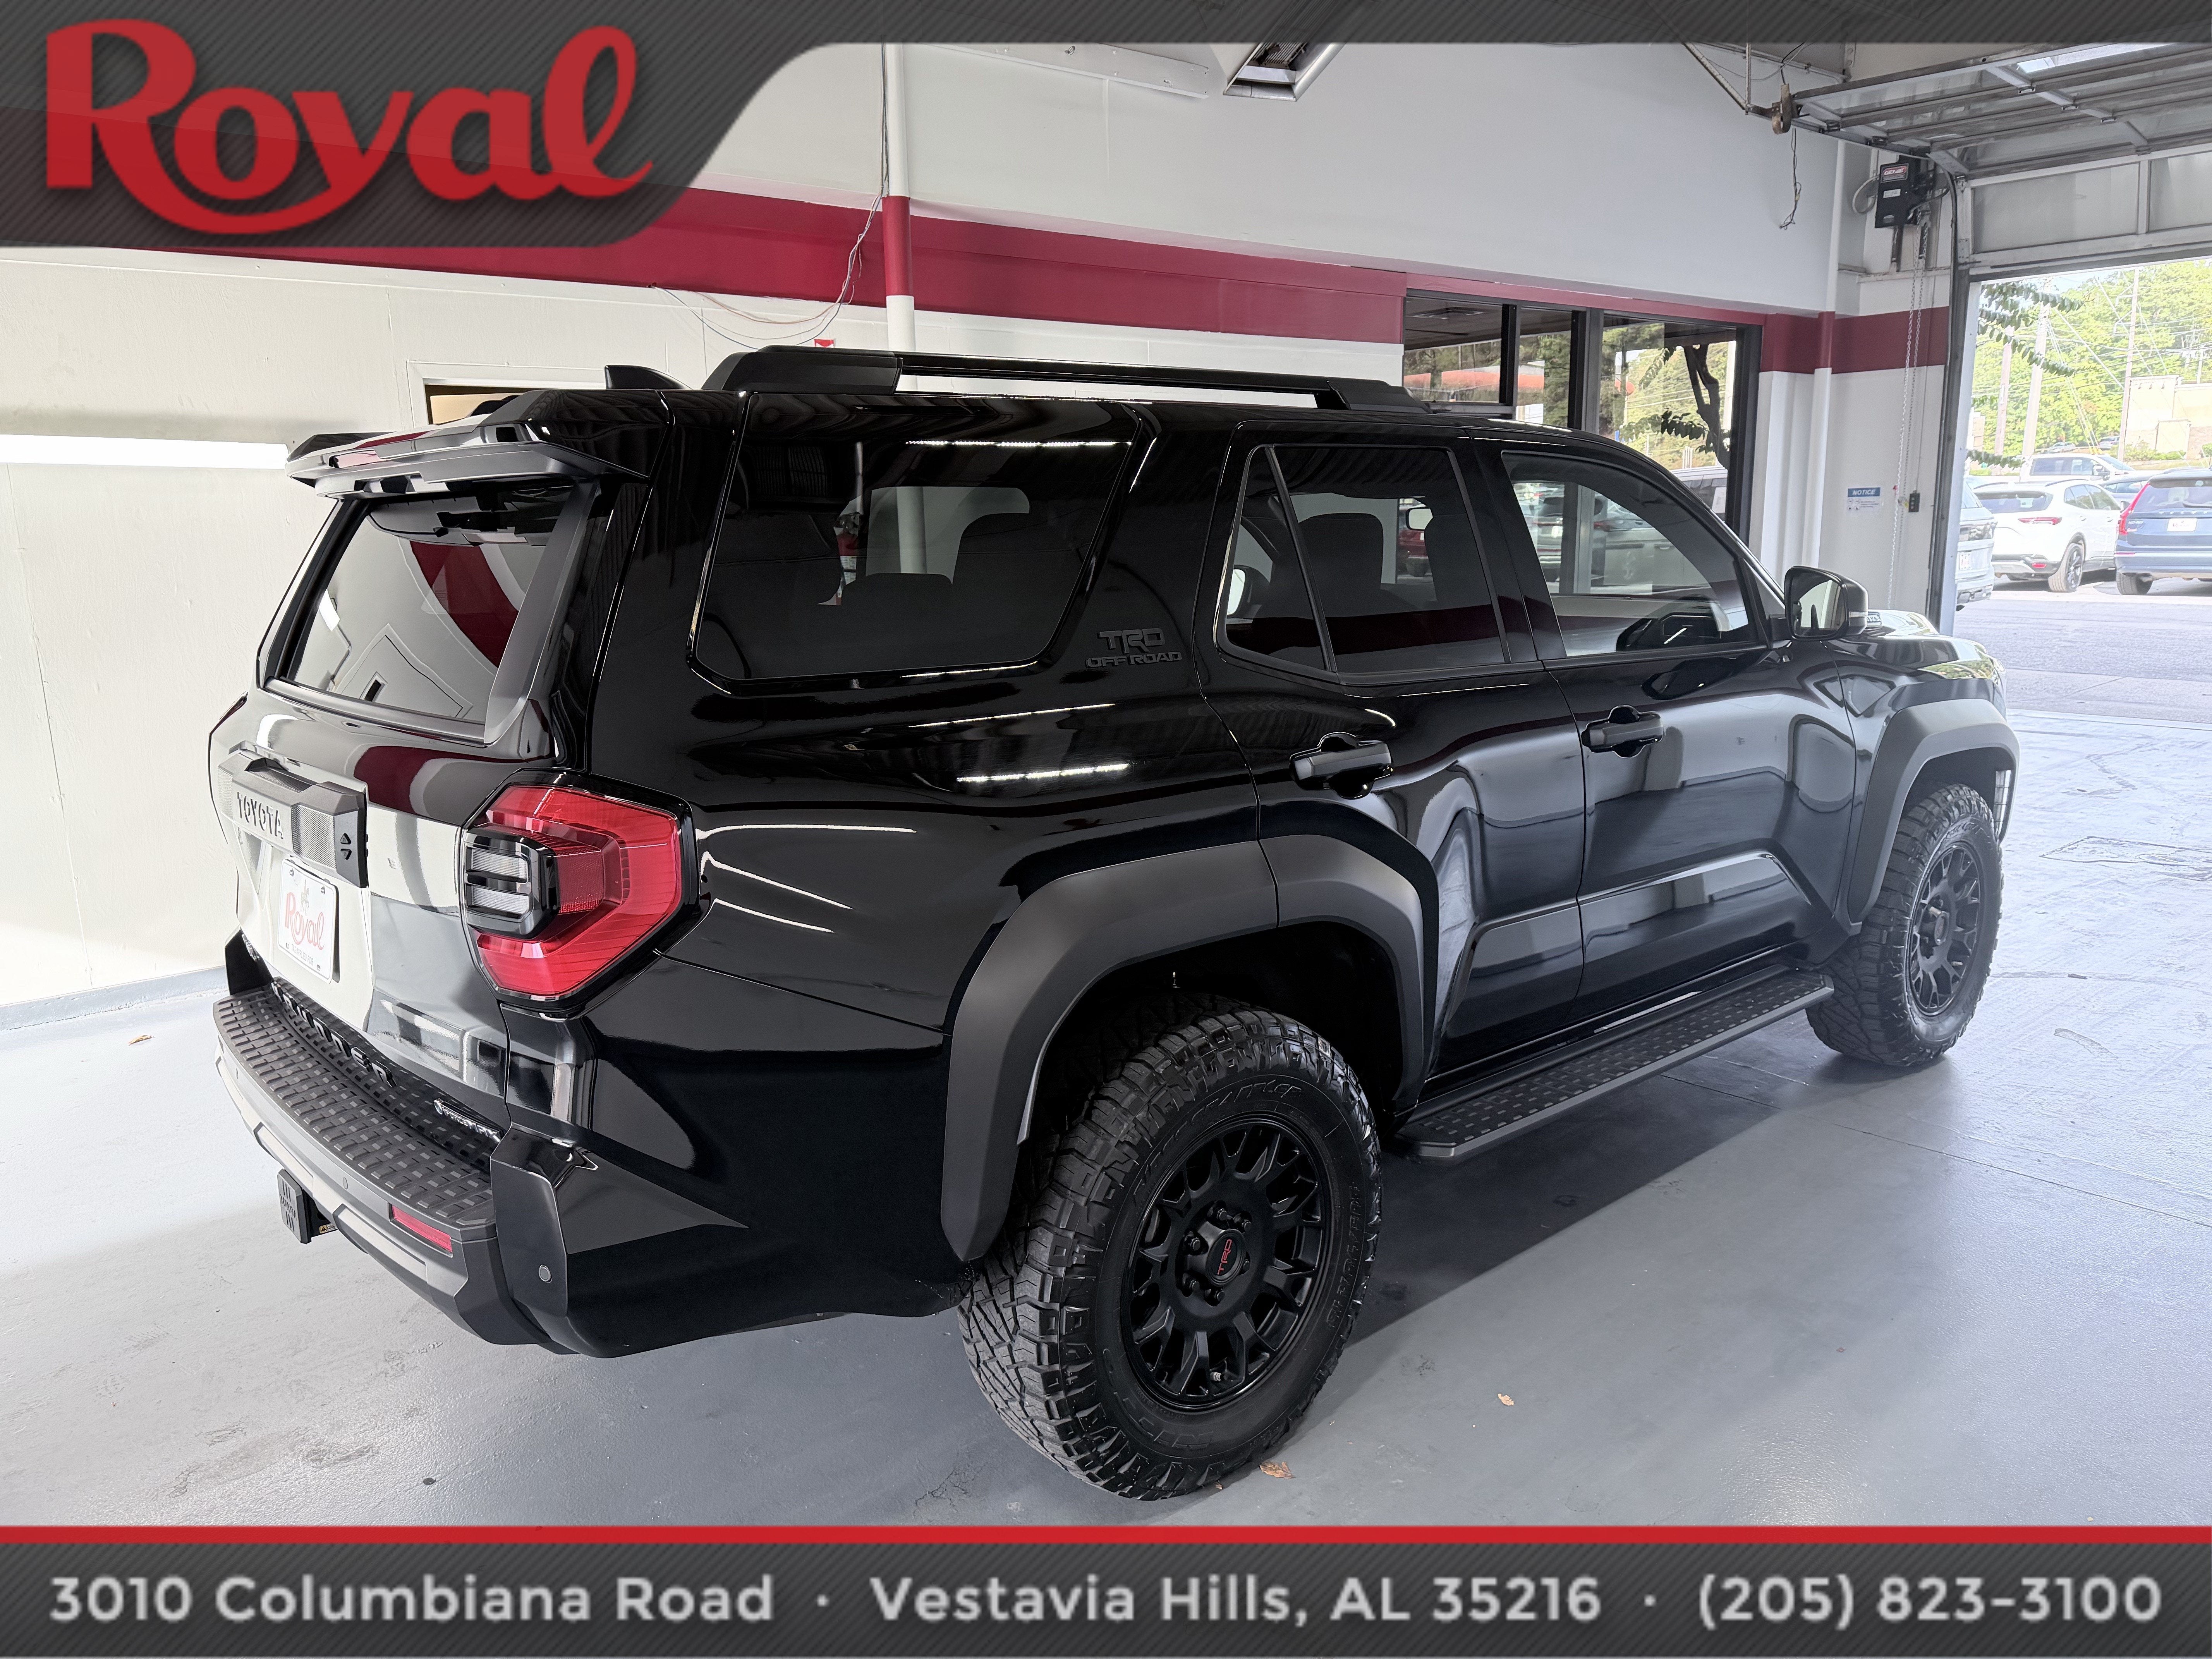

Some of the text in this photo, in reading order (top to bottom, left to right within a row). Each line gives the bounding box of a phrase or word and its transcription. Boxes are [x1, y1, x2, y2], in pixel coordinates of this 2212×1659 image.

[1097, 628, 1165, 654] TRD
[1085, 651, 1183, 669] OFF ROAD
[237, 792, 284, 840] TOYOTA
[285, 892, 325, 950] Royal
[1217, 1238, 1233, 1275] TRD
